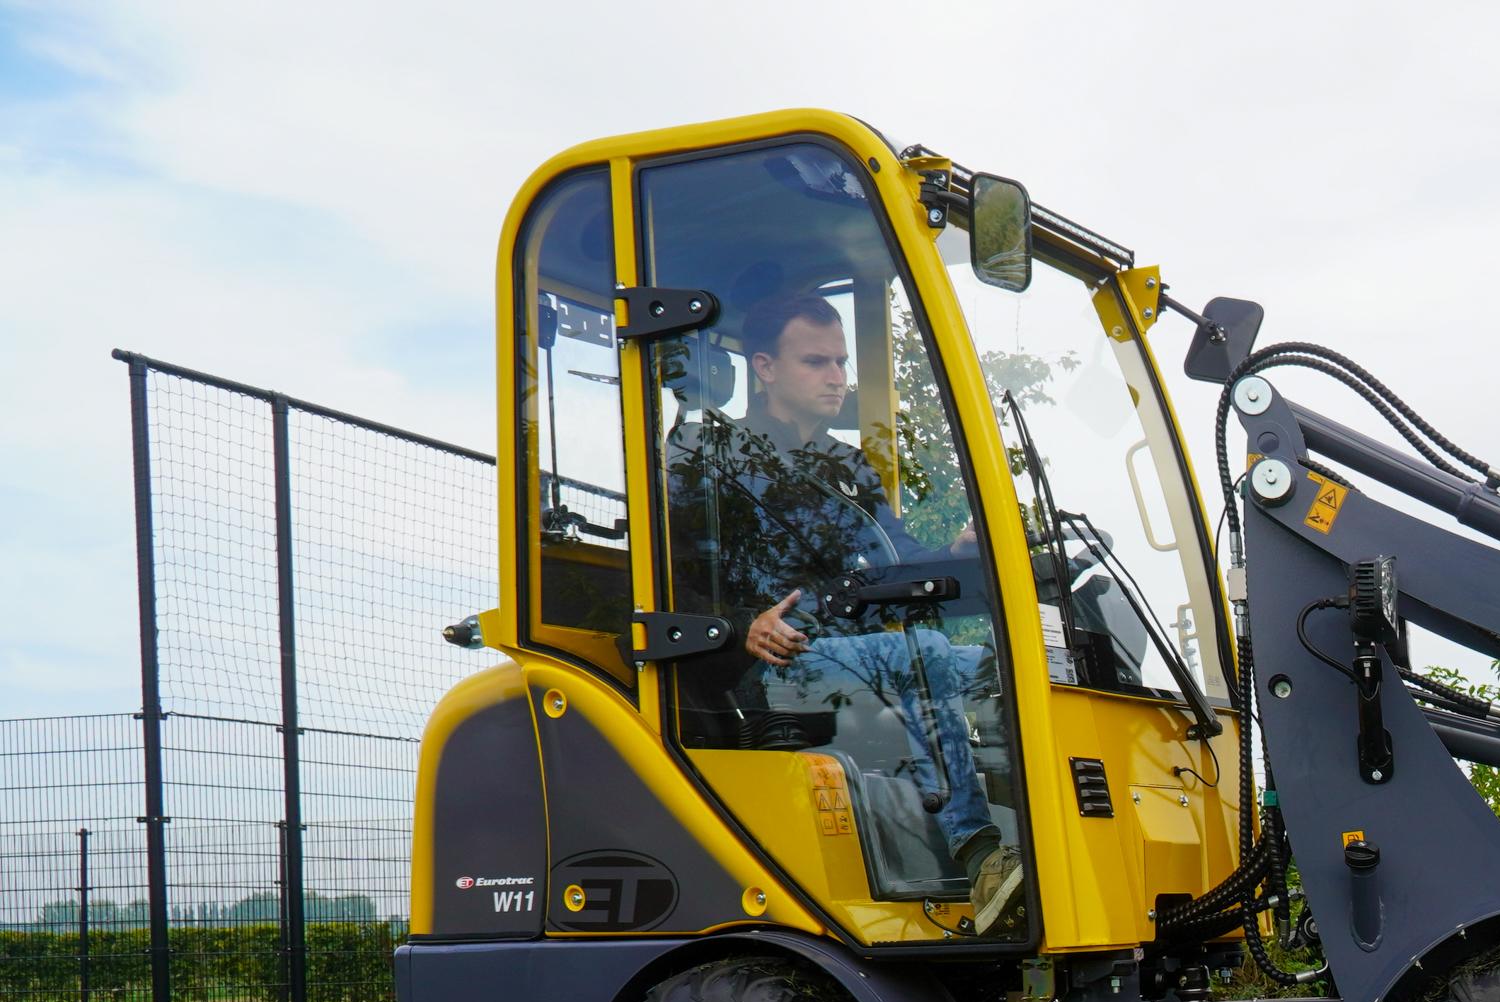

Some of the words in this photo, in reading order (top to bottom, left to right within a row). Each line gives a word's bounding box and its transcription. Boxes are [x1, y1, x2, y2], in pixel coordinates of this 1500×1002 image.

[457, 877, 474, 888] ET
[475, 877, 534, 887] Eurotrac
[493, 890, 534, 912] W11
